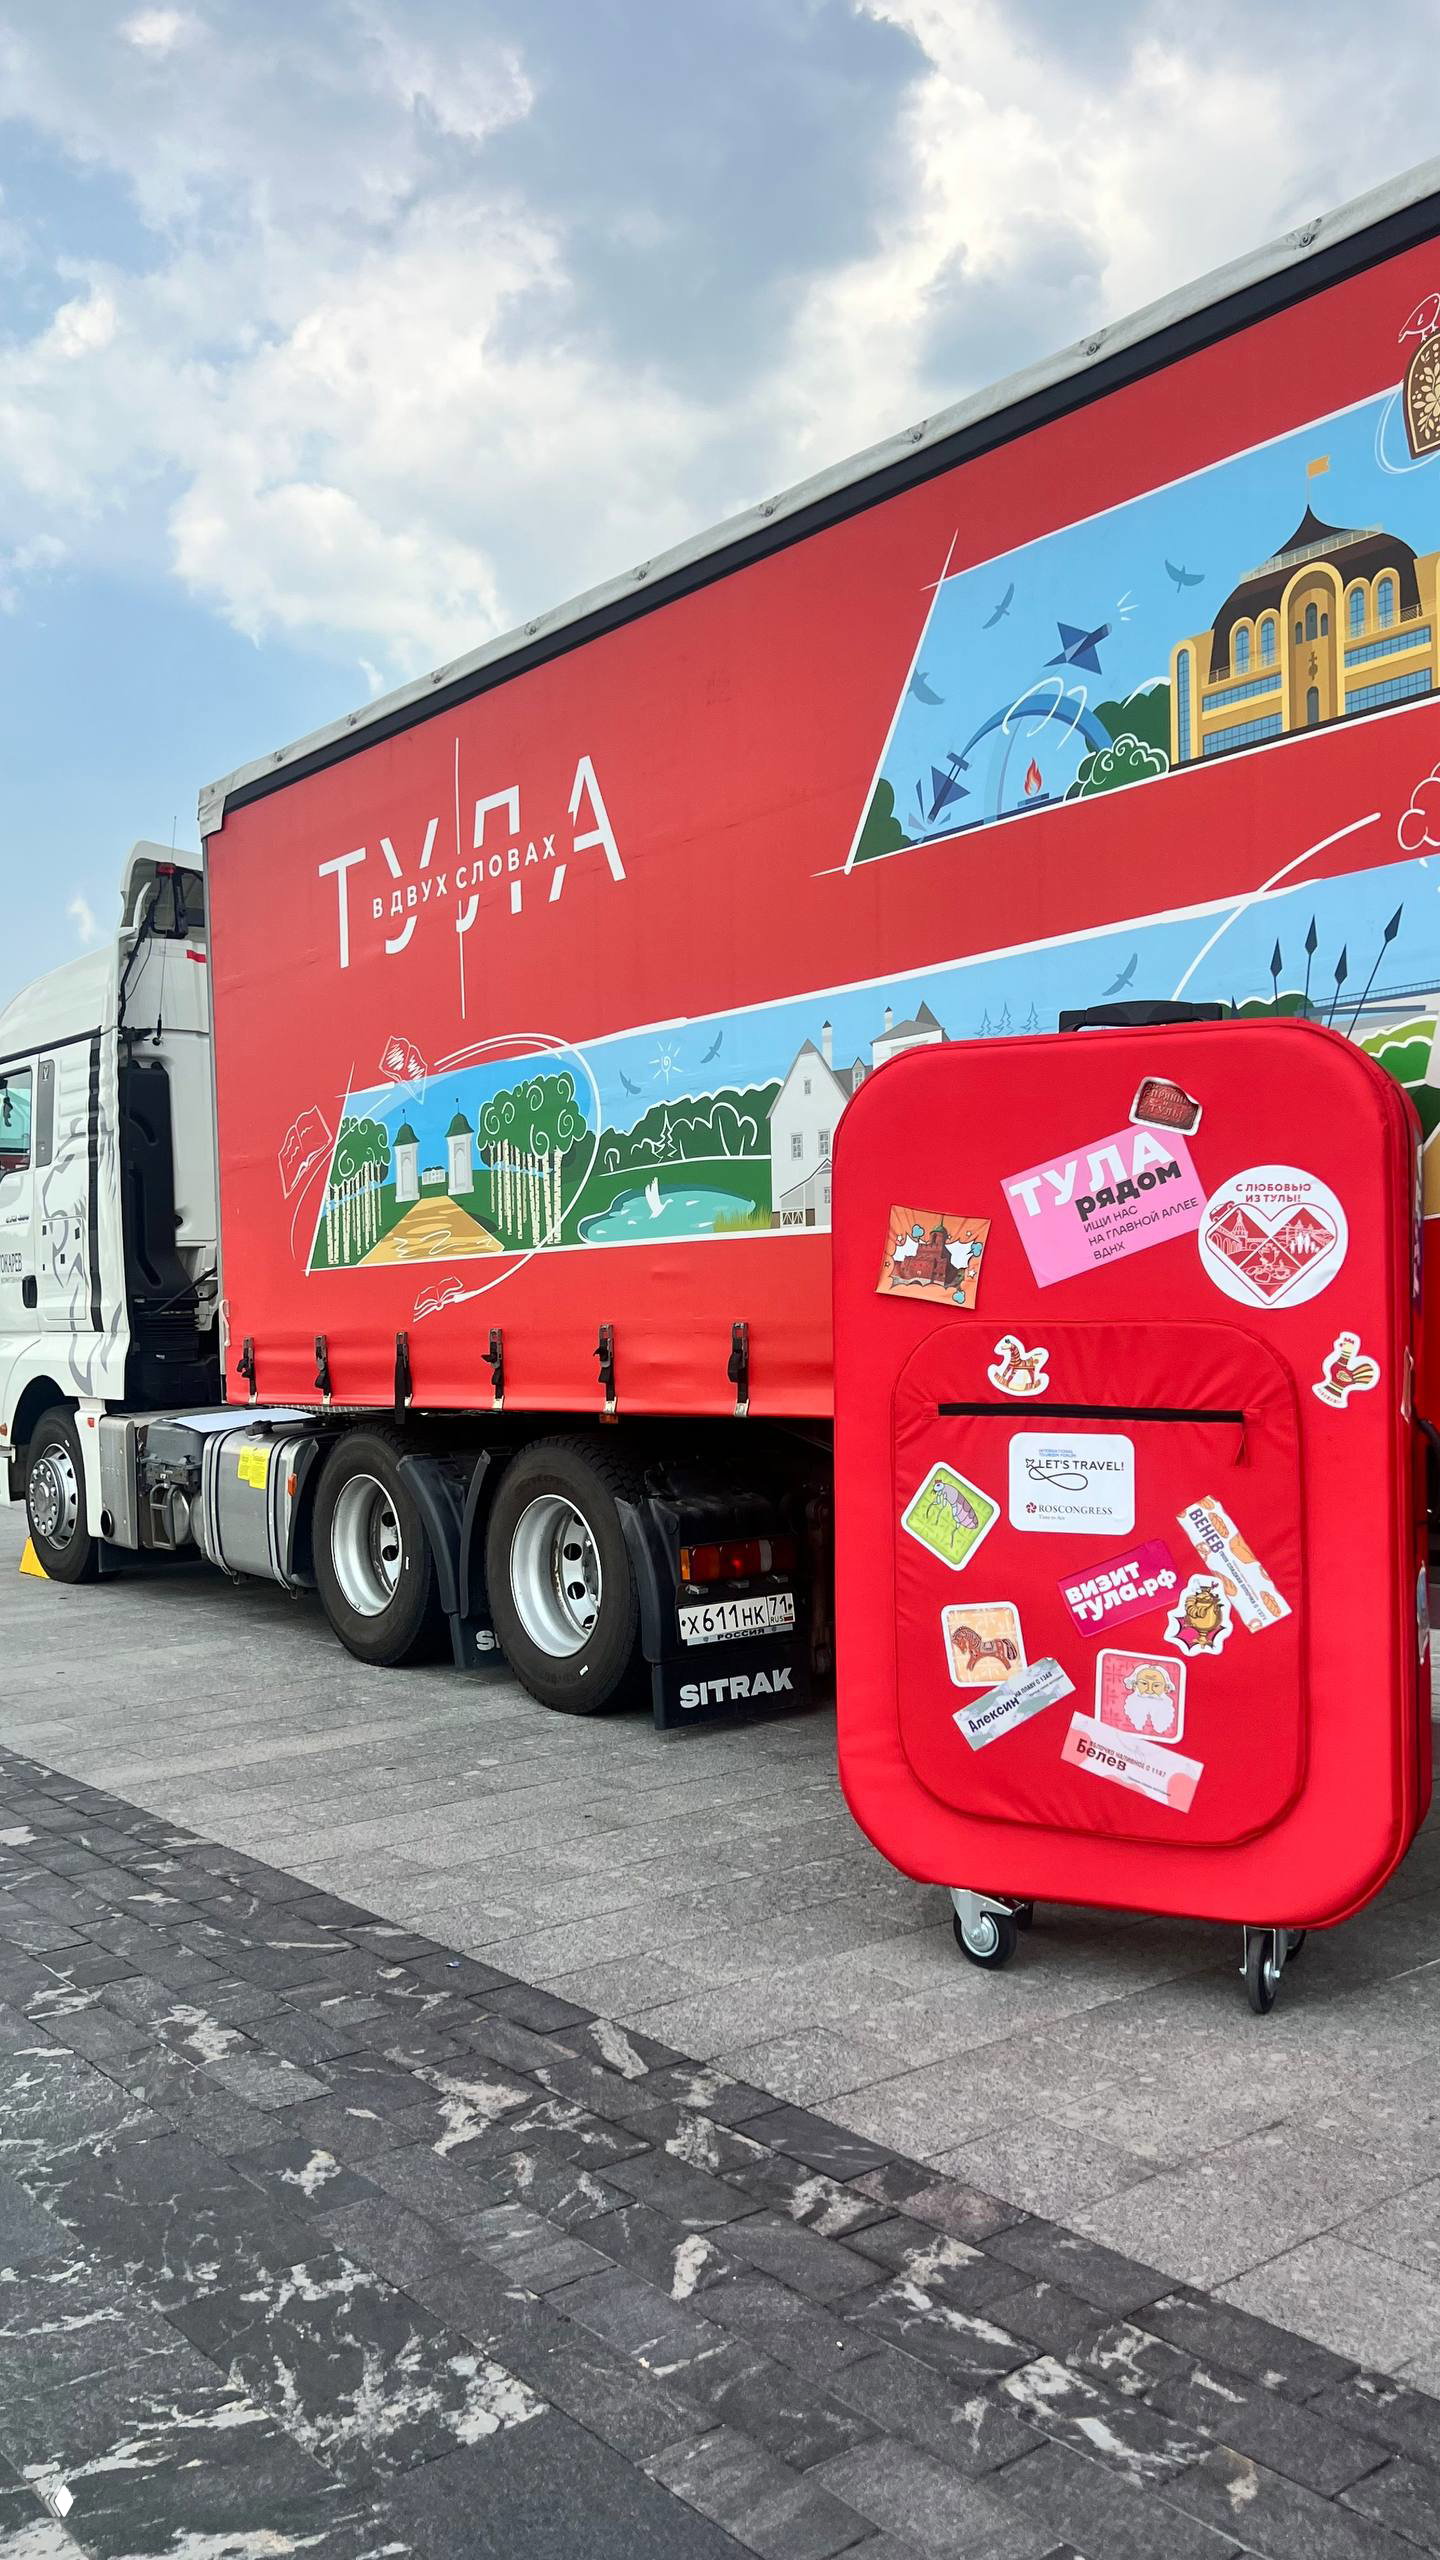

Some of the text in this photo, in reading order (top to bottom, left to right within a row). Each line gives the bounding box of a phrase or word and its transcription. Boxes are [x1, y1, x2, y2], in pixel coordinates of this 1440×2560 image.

[372, 833, 557, 919] В ДВУХ СЛОВАХ
[1008, 1131, 1174, 1216] ТУЛА
[1235, 1183, 1312, 1192] С ЛЮБОВЬЮ
[1075, 1160, 1182, 1222] рядом
[1245, 1194, 1301, 1203] ИЗ ТУЛЫ!
[1083, 1205, 1138, 1233] ИЩИ НАС
[1088, 1196, 1199, 1247] НА ГЛАВНОЙ АЛЛЕЕ
[0, 1252, 22, 1272] ОКАРЕВ
[1093, 1241, 1126, 1260] ВДНХ
[1039, 1459, 1124, 1472] LET'S TRAVEL!
[1039, 1503, 1113, 1515] ROSCONGRESS
[1188, 1508, 1225, 1554] ВЕНЕВ
[687, 1595, 788, 1635] Х611НК 71
[770, 1615, 784, 1624] RUS
[717, 1628, 766, 1641] РОССИЯ
[679, 1667, 794, 1709] SITRAK
[968, 1697, 1020, 1733] Алексин
[1076, 1738, 1127, 1772] Белев
